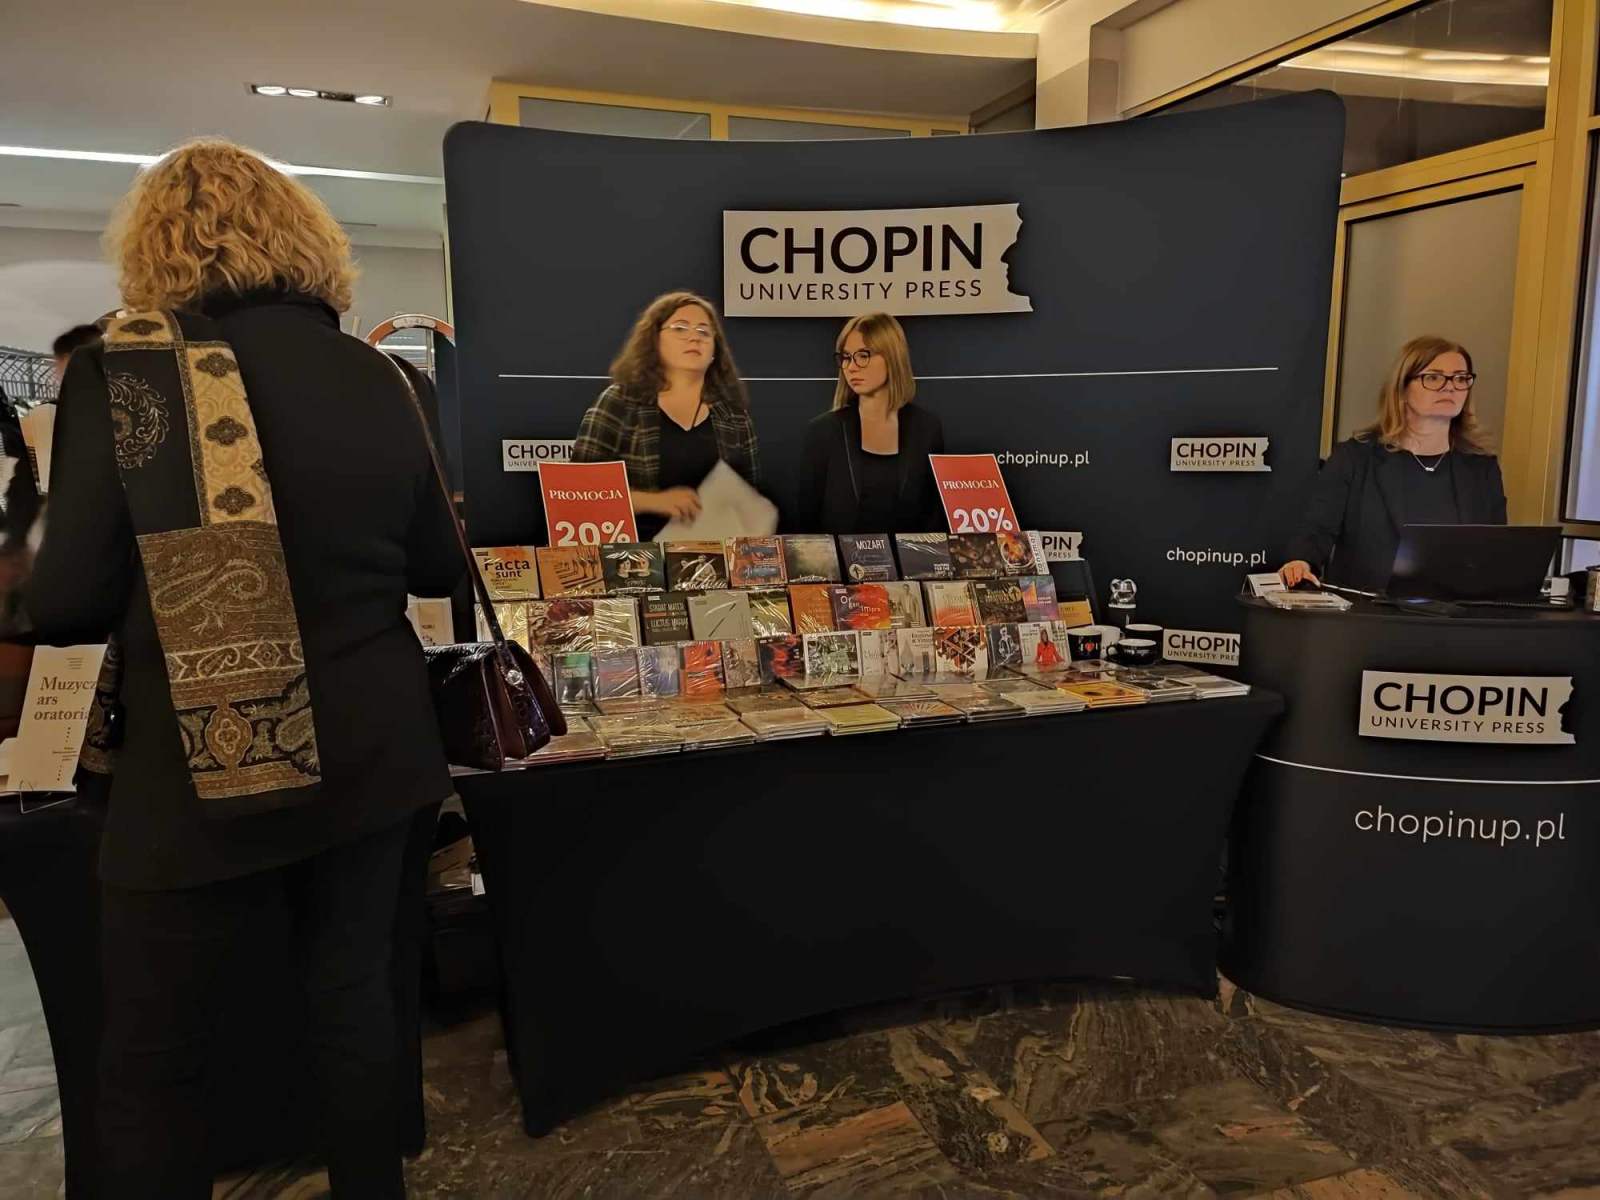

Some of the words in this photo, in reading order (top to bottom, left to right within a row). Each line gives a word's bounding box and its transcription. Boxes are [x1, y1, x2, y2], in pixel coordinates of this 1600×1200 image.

[740, 222, 983, 274] CHOPIN
[739, 282, 893, 300] UNIVERSITY
[906, 279, 982, 298] PRESS
[1176, 442, 1257, 458] CHOPIN
[997, 450, 1090, 468] chopinup.pl
[1175, 459, 1226, 467] UNIVERSITY
[1229, 459, 1256, 467] PRESS
[942, 479, 1000, 490] PROMOCJA
[549, 489, 624, 501] PROMOCJA
[953, 507, 1013, 533] 20%
[555, 519, 631, 546] 20%
[855, 539, 885, 550] MOZART
[1042, 536, 1072, 551] PIN
[1048, 551, 1072, 559] PRESS
[1166, 547, 1267, 568] chopinup.pl
[495, 569, 522, 579] sunt
[1167, 650, 1217, 660] UNIVERSITY
[36, 695, 58, 705] ars
[1373, 681, 1548, 718] CHOPIN
[1371, 716, 1485, 733] UNIVERSITY
[1491, 721, 1545, 733] PRESS
[1354, 805, 1566, 847] chopinup.pl
